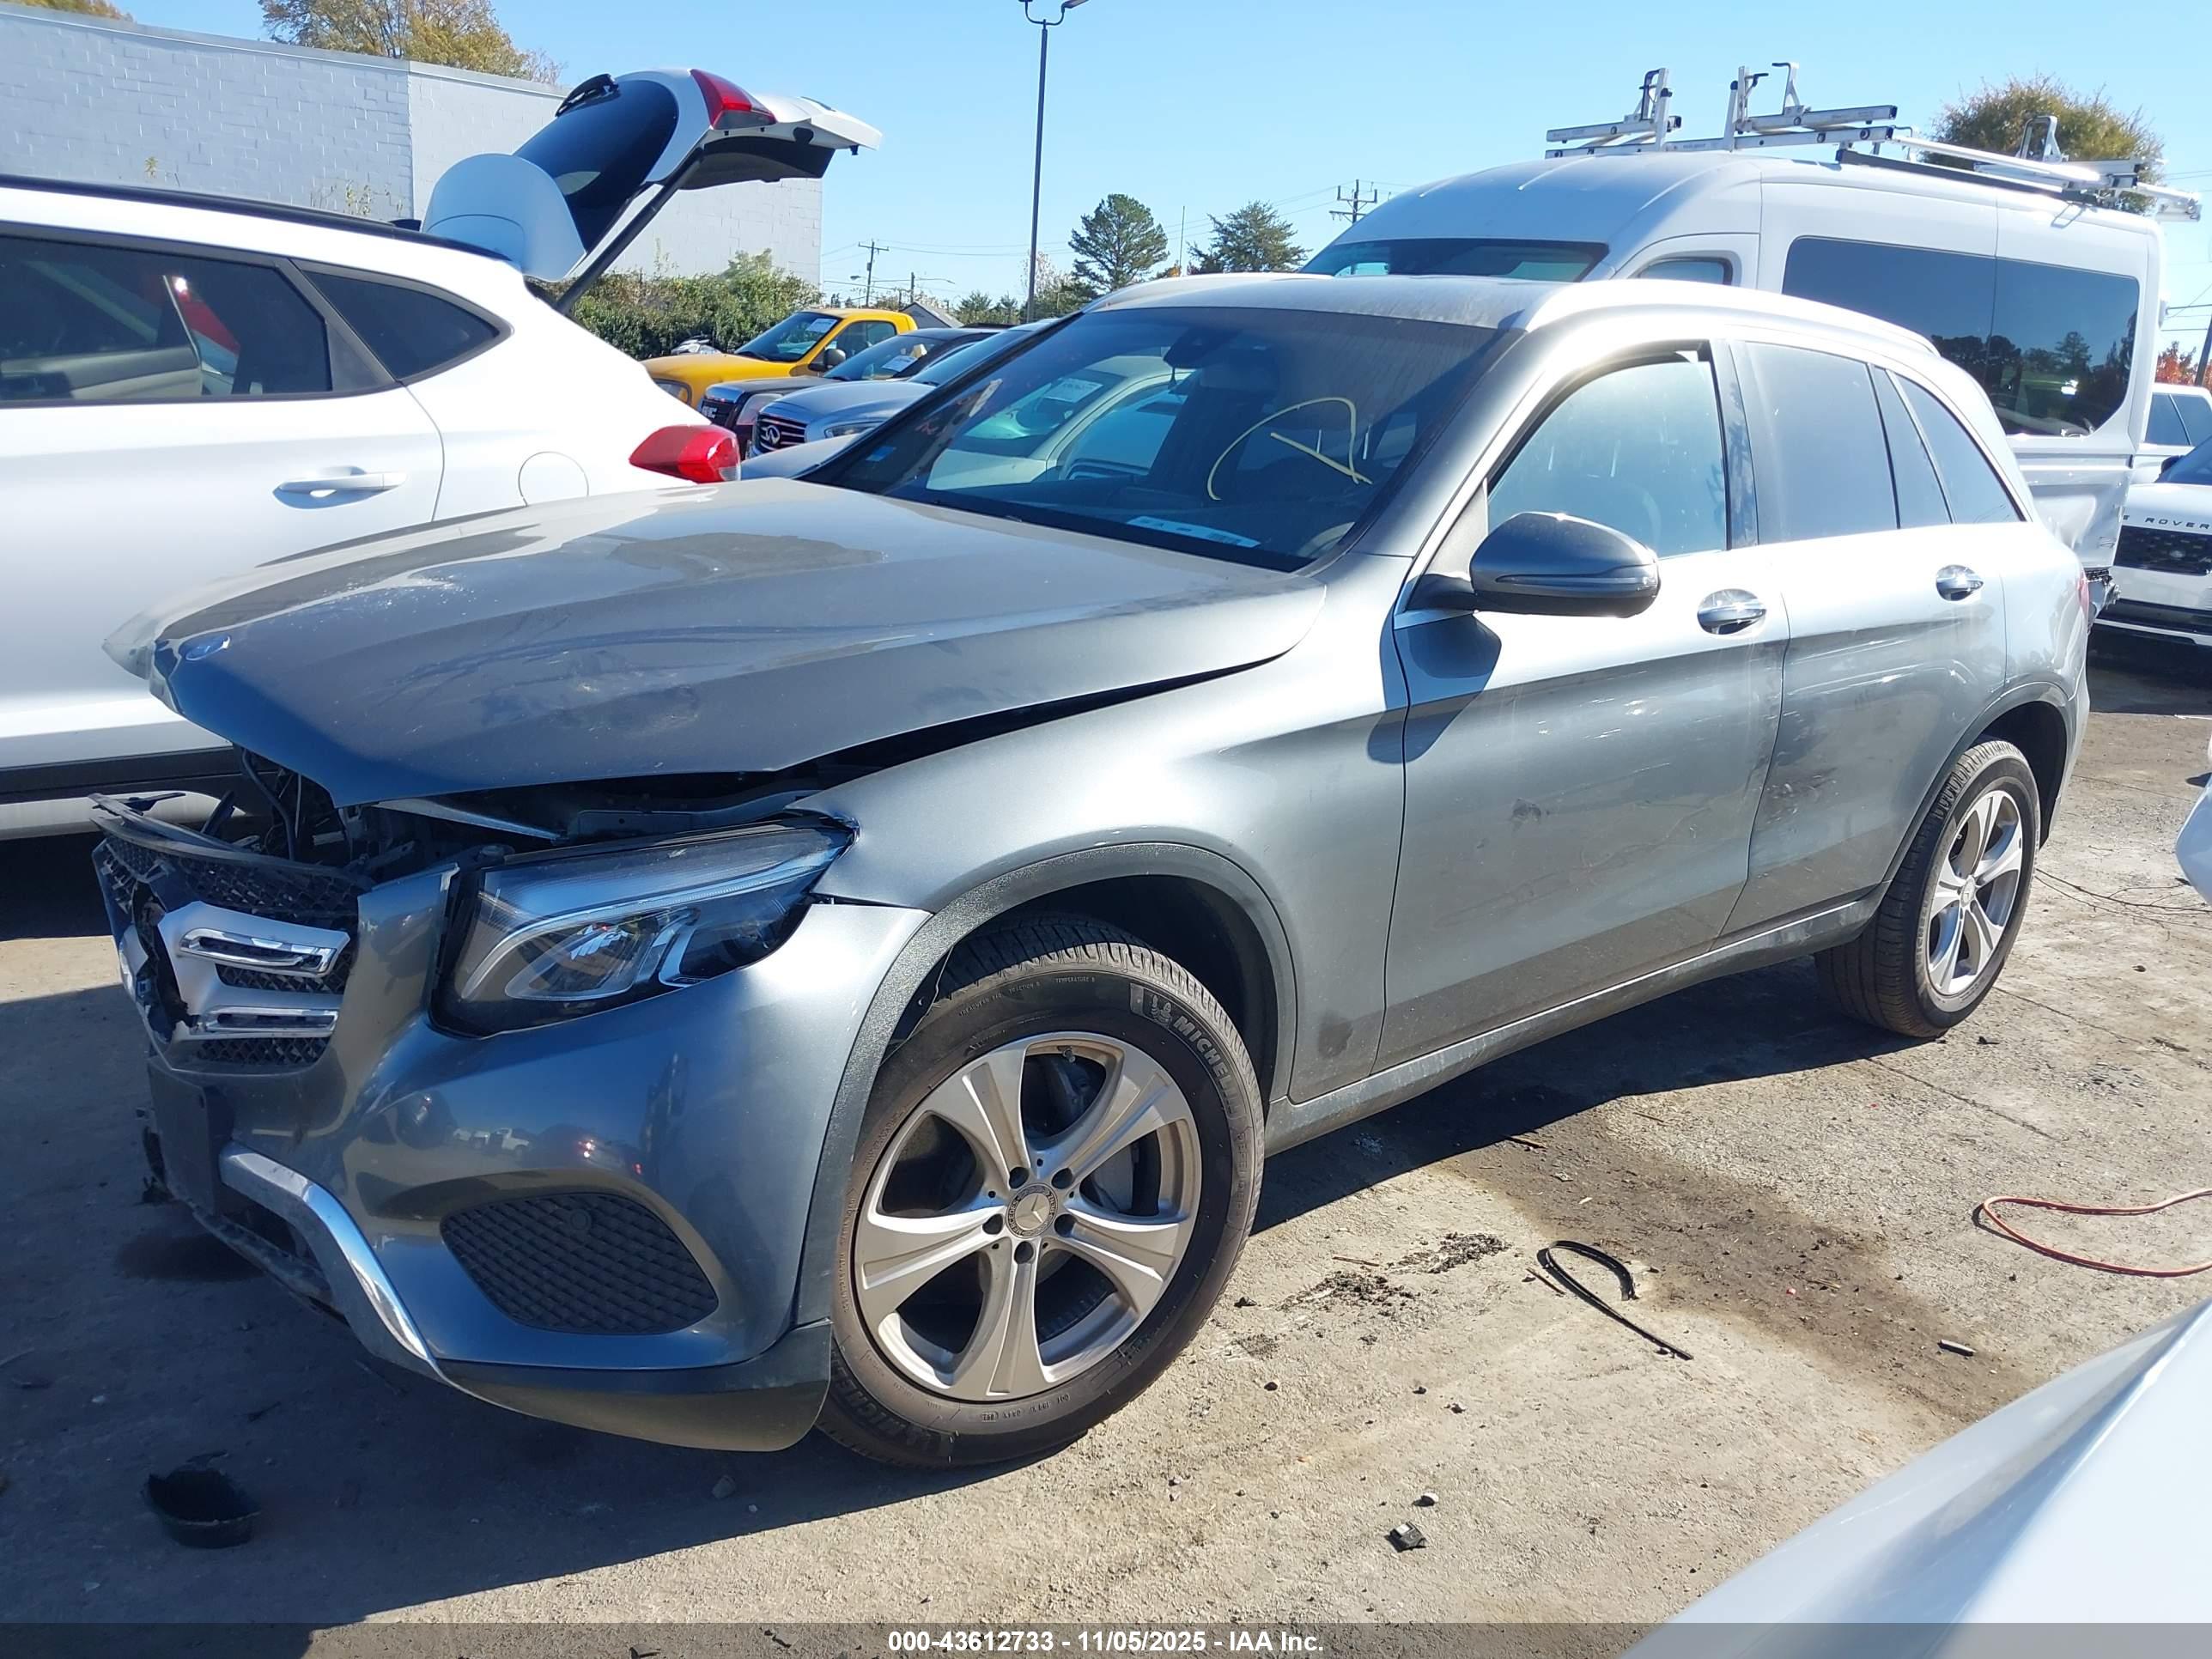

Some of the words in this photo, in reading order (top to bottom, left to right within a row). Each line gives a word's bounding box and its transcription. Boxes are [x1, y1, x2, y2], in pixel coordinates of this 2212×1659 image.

[2145, 518, 2210, 529] ROVER
[1173, 1015, 1239, 1115] MICHELIN
[1008, 1200, 1023, 1235] MERCEDES
